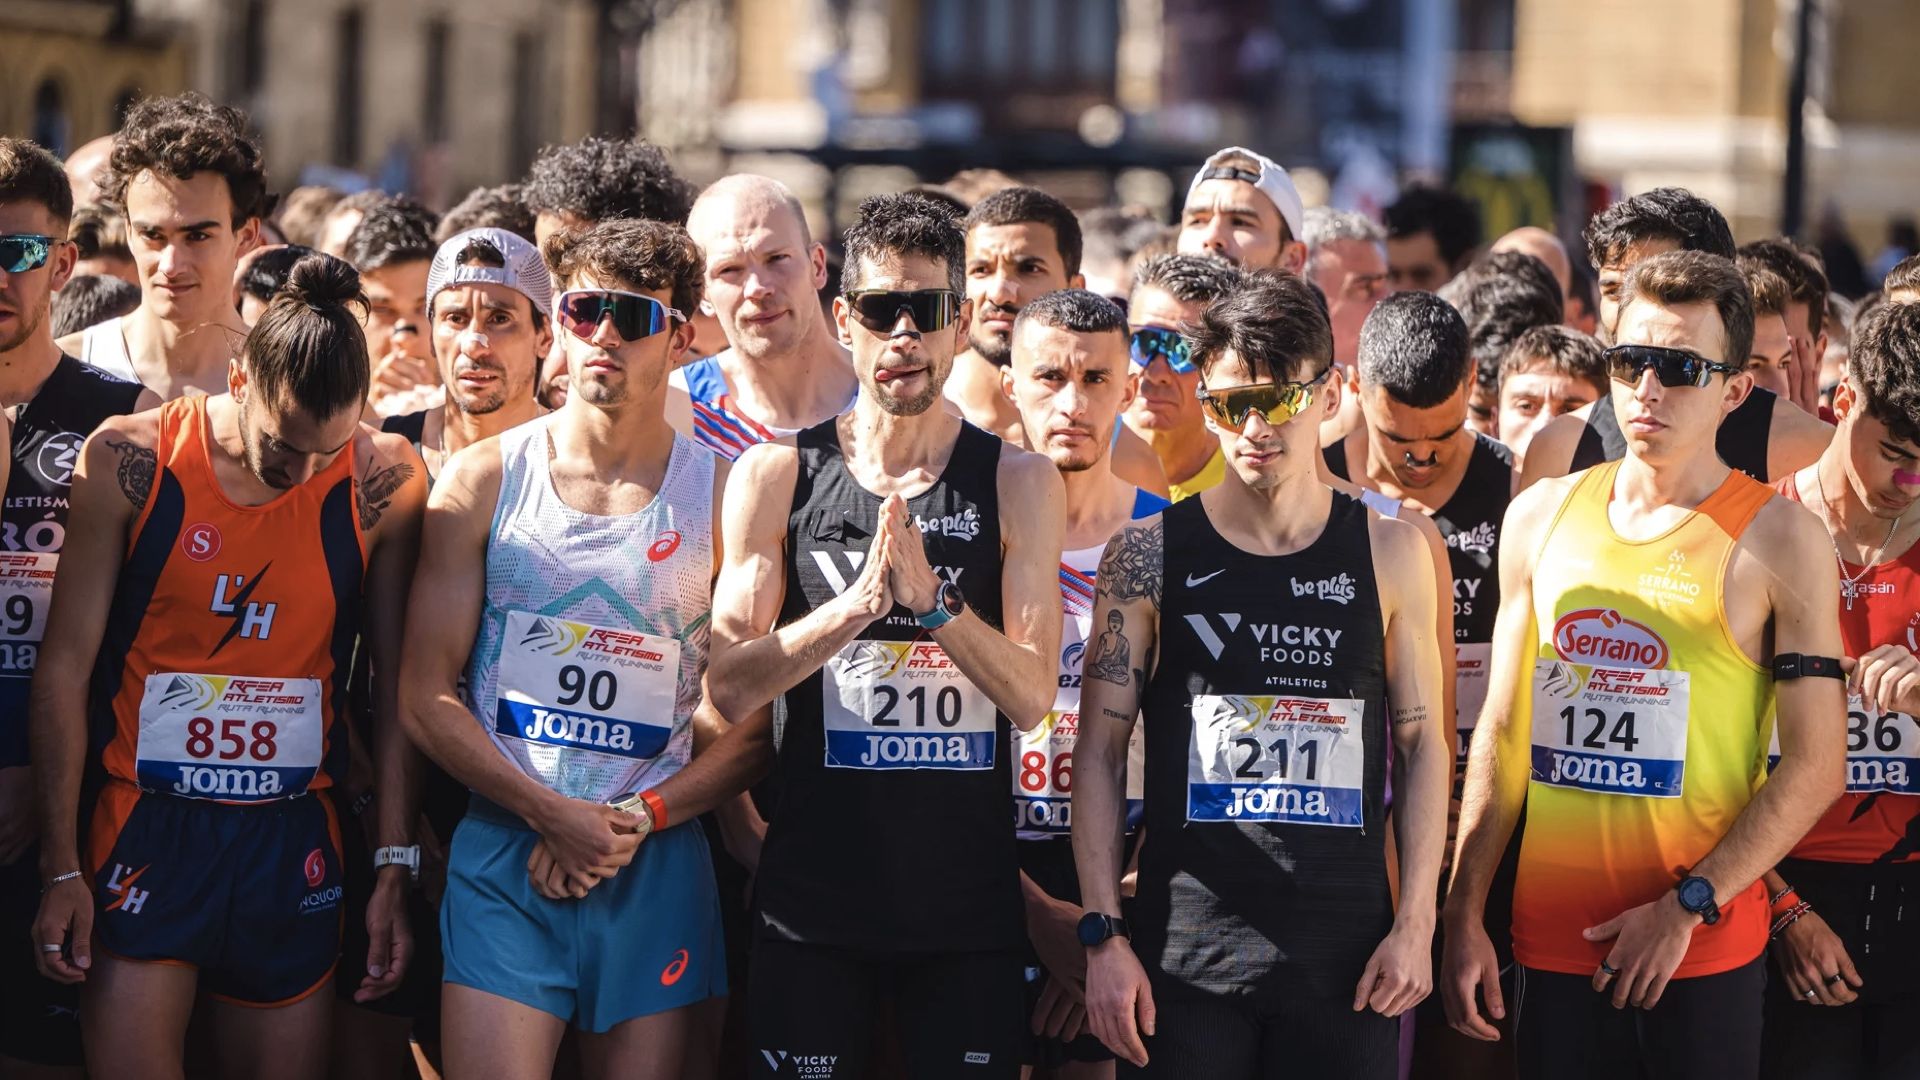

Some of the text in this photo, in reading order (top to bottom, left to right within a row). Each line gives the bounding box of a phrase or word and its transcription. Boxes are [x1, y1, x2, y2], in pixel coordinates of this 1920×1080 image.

[915, 509, 981, 542] be plus
[191, 530, 211, 553] S
[1290, 572, 1356, 605] be plus
[589, 628, 645, 646] RFEA
[1249, 623, 1342, 649] VICKY
[1561, 623, 1658, 665] Serrano
[576, 650, 665, 672] RUTA RUNNING
[582, 641, 664, 662] ATLETISMO
[1261, 647, 1333, 667] FOODS
[902, 671, 937, 680] RUTA
[1265, 676, 1328, 689] ATHLETICS
[1592, 668, 1646, 683] RFEA
[229, 679, 285, 693] RFEA
[556, 664, 618, 712] 90
[1587, 681, 1669, 696] ATLETISMO
[217, 703, 305, 714] RUTA RUNNING
[223, 693, 305, 705] ATLETISMO
[872, 684, 963, 728] 210
[1274, 699, 1330, 712] RFEA
[1582, 692, 1672, 706] RUTA RUNNING
[1268, 713, 1346, 725] ATLETISMO
[1559, 705, 1640, 752] 124
[185, 716, 278, 762] 858
[1300, 724, 1350, 735] RUNNING
[1847, 711, 1902, 752] 36
[1235, 737, 1318, 781] 211
[1020, 750, 1072, 793] 86
[792, 1055, 838, 1066] VICKY
[798, 1066, 833, 1074] FOODS
